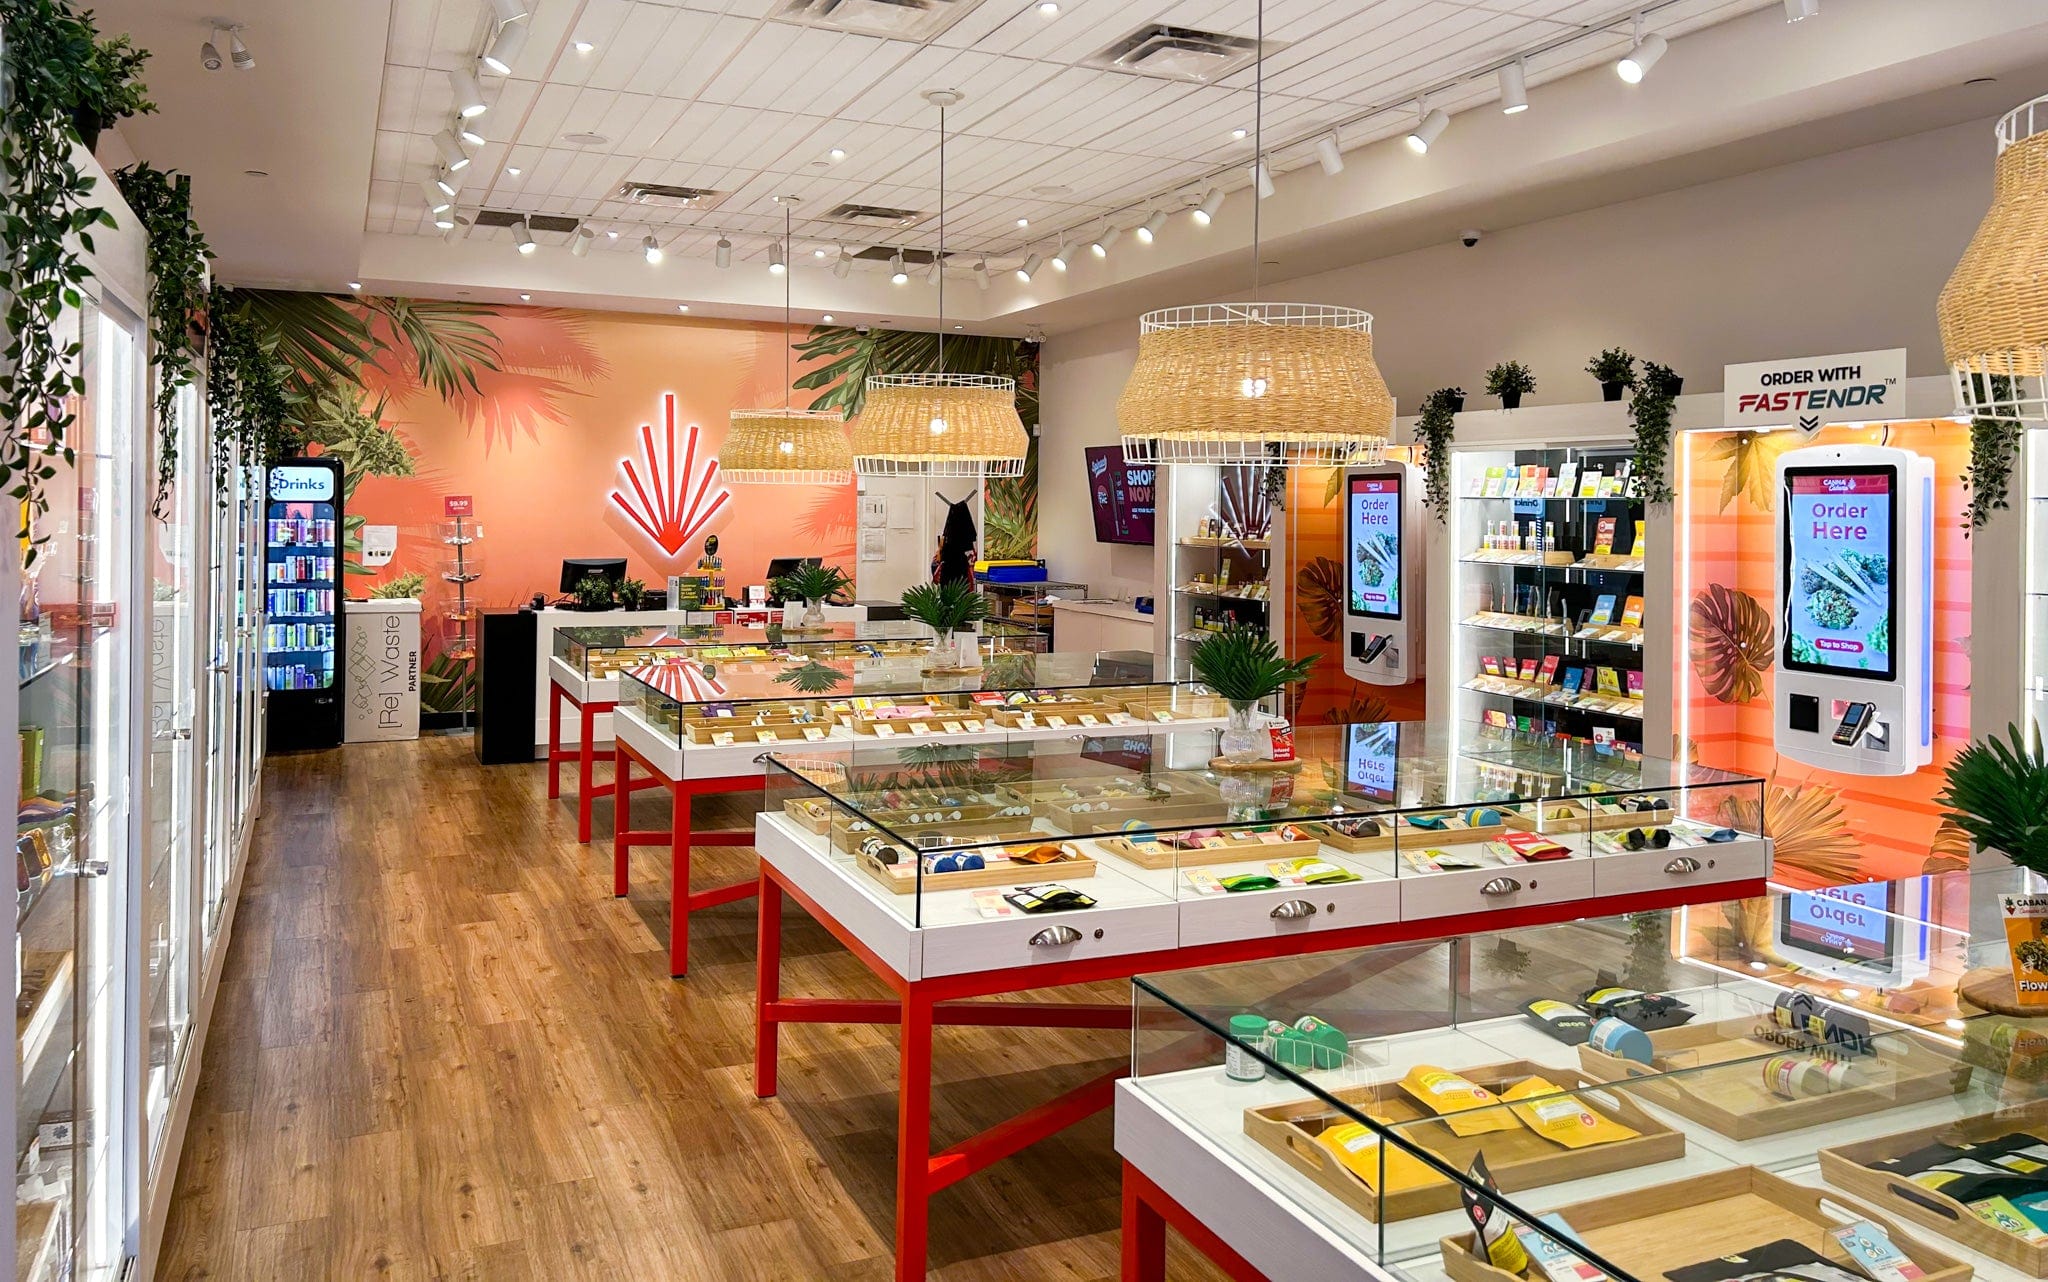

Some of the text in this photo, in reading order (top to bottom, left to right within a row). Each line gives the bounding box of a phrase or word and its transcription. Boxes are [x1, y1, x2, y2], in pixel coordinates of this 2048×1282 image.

[1761, 365, 1861, 386] ORDER WITH
[1739, 384, 1886, 413] FASTENDR
[279, 478, 325, 490] Drinks
[1362, 498, 1389, 510] Order
[1812, 502, 1868, 518] Order
[1362, 512, 1389, 525] Here
[1812, 521, 1867, 540] Here
[1820, 640, 1832, 649] Tap
[1841, 642, 1859, 651] Shop
[378, 615, 403, 728] [Re] Waste
[408, 651, 417, 692] PARTNER
[2016, 899, 2048, 907] CABAN
